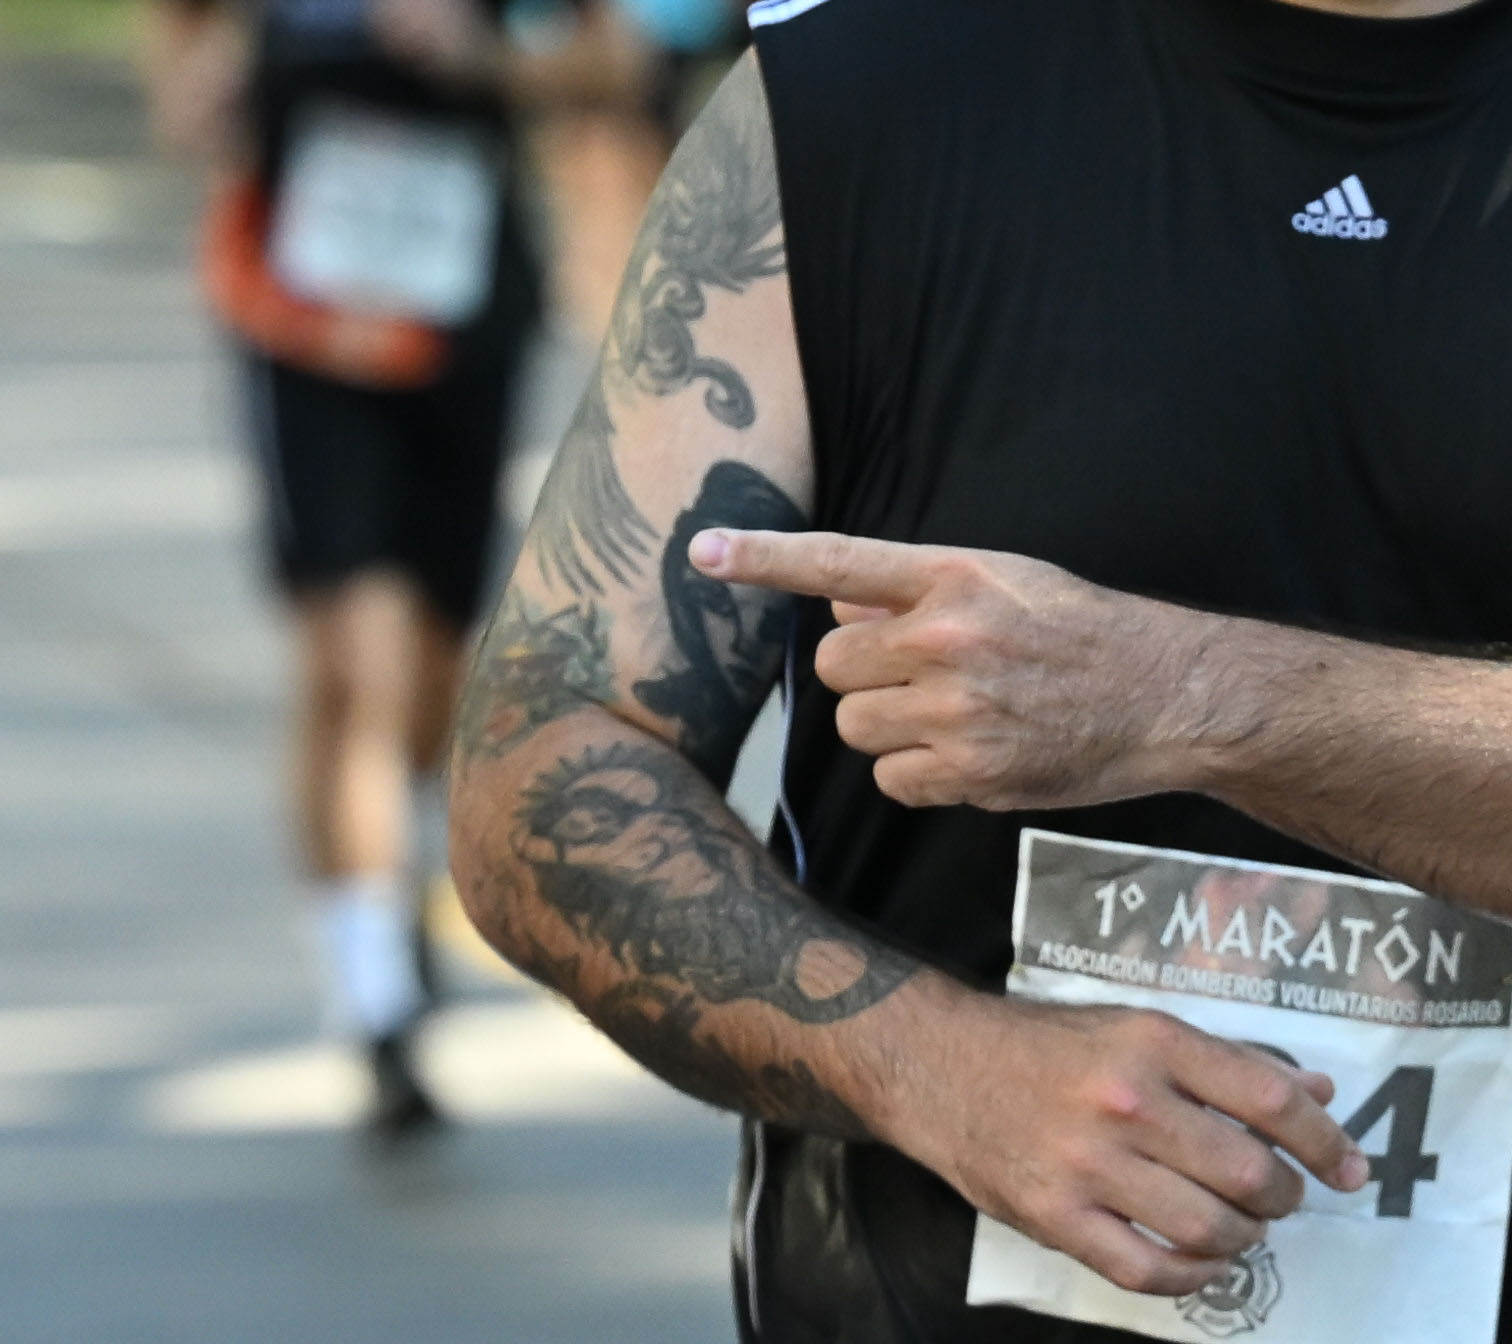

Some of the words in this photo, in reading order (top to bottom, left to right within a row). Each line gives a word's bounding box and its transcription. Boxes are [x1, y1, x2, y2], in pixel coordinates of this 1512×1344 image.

[1291, 211, 1388, 240] adidas
[1159, 890, 1465, 986] MARATÓN
[1038, 940, 1159, 984] ASOCIACIÓN
[1160, 962, 1276, 1003] BOMBEROS
[1280, 979, 1418, 1023] VOLUNTARIOS
[1422, 998, 1503, 1024] ROSARIO
